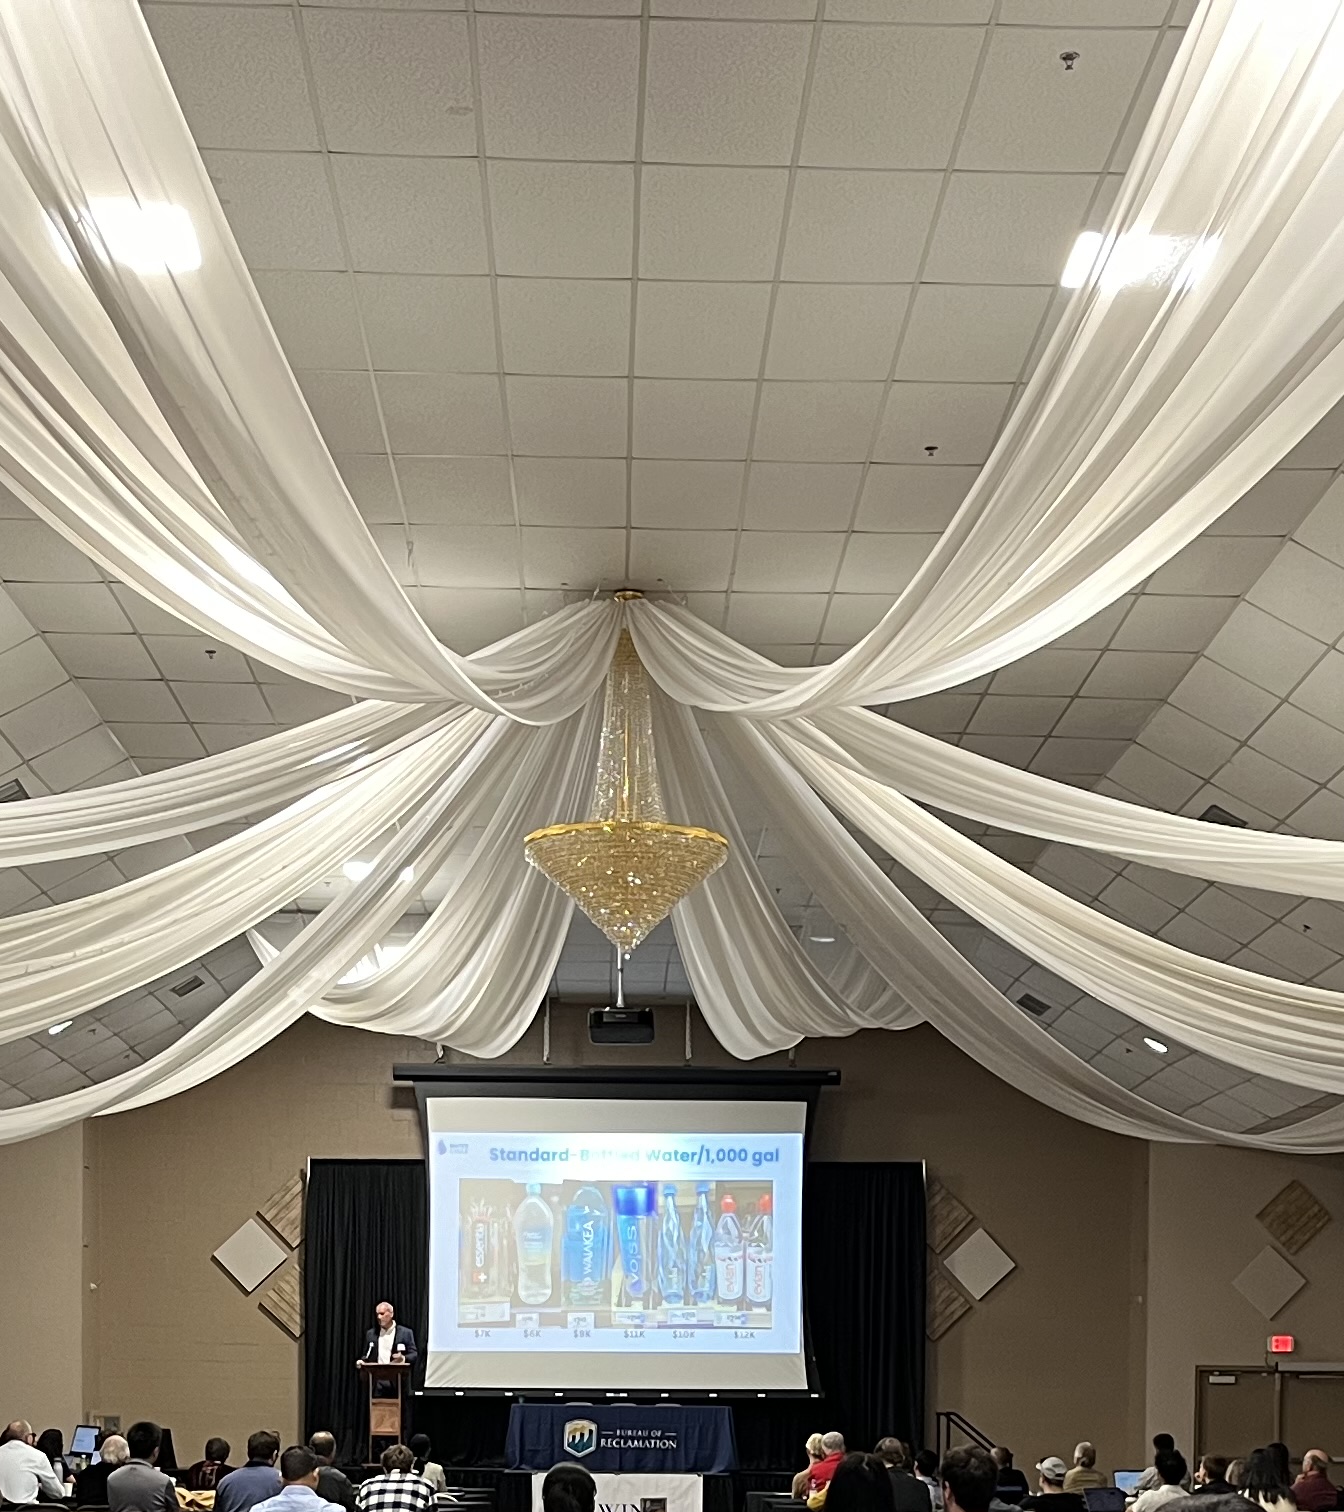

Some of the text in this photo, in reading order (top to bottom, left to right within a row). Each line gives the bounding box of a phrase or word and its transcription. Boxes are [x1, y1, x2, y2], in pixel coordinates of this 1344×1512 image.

[752, 1148, 780, 1167] gal
[616, 1429, 663, 1438] BUREAU OF
[600, 1438, 678, 1449] RECLAMATION
